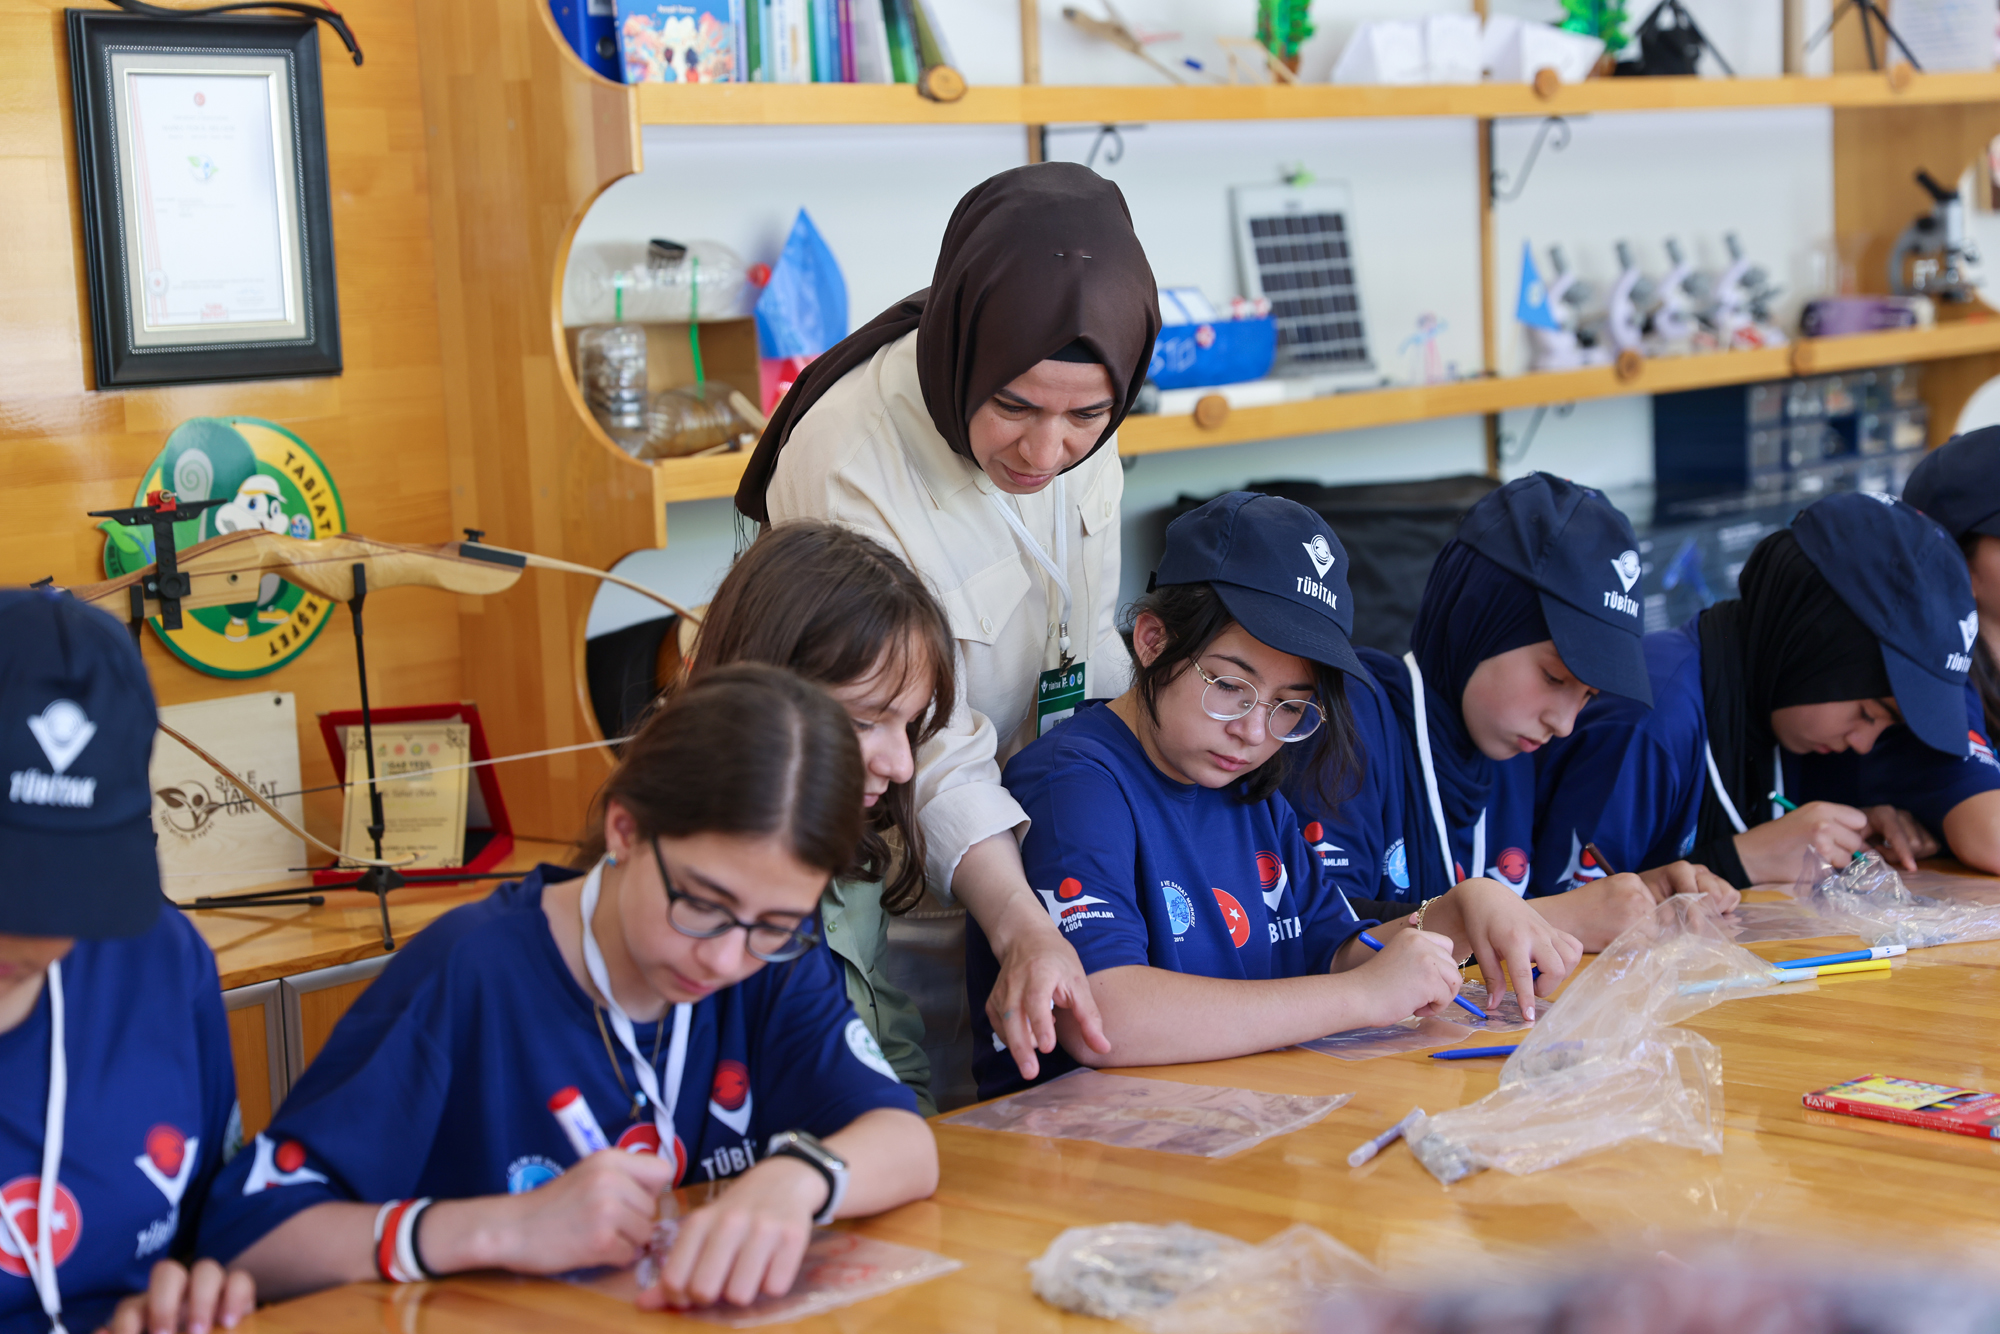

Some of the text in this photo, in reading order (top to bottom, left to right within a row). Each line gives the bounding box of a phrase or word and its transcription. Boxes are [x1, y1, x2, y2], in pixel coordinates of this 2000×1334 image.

[1297, 576, 1337, 610] TÜBİTAK
[269, 600, 320, 658] EŞFET
[1321, 858, 1349, 866] AMLARI
[1060, 905, 1089, 919] DESTEK
[1061, 911, 1115, 927] PROGRAMLARI
[1065, 919, 1083, 933] 4004
[701, 1139, 758, 1181] TÜBİ
